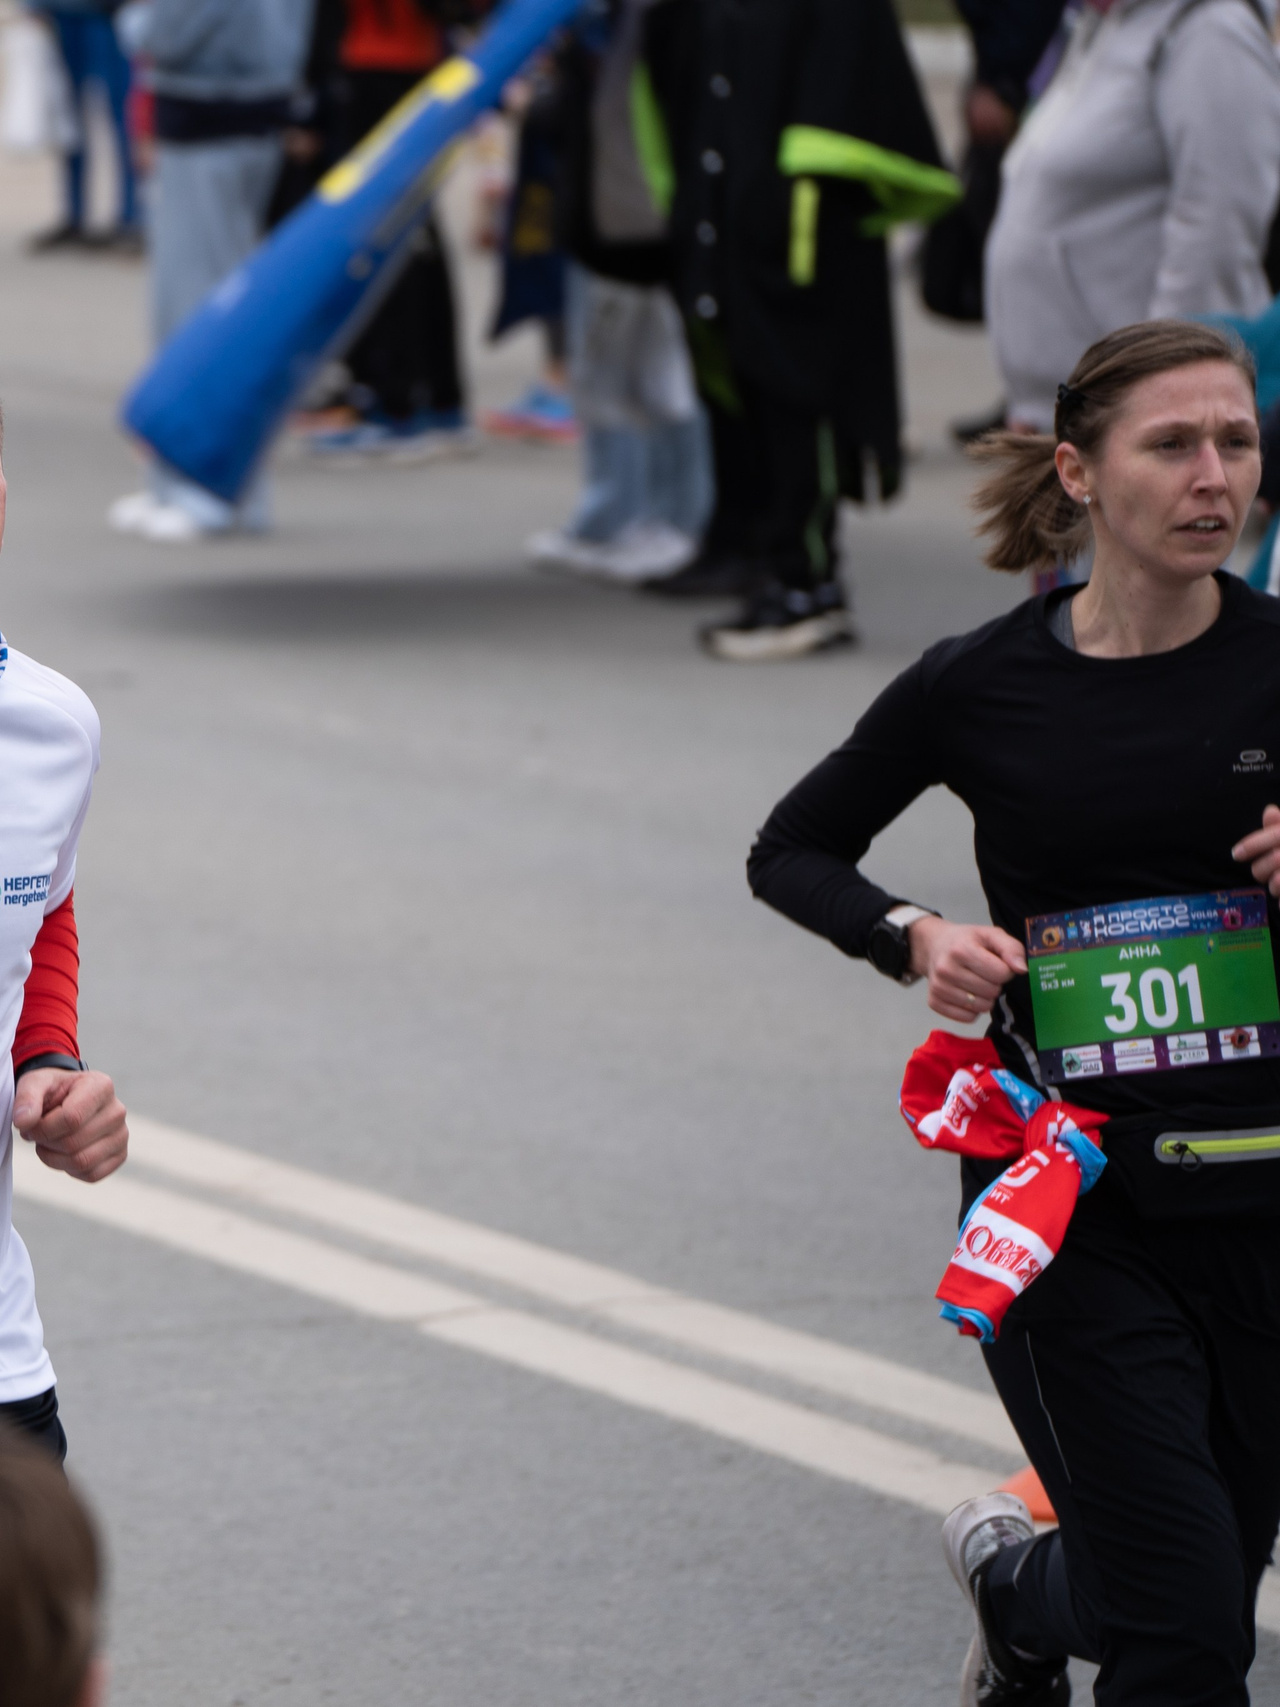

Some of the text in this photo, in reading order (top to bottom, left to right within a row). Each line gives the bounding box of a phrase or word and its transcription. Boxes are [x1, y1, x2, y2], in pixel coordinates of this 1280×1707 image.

[1108, 904, 1188, 922] ПРОСТО
[1095, 914, 1190, 939] КОСМОС
[1119, 943, 1161, 961] АННА
[1100, 963, 1205, 1034] 301
